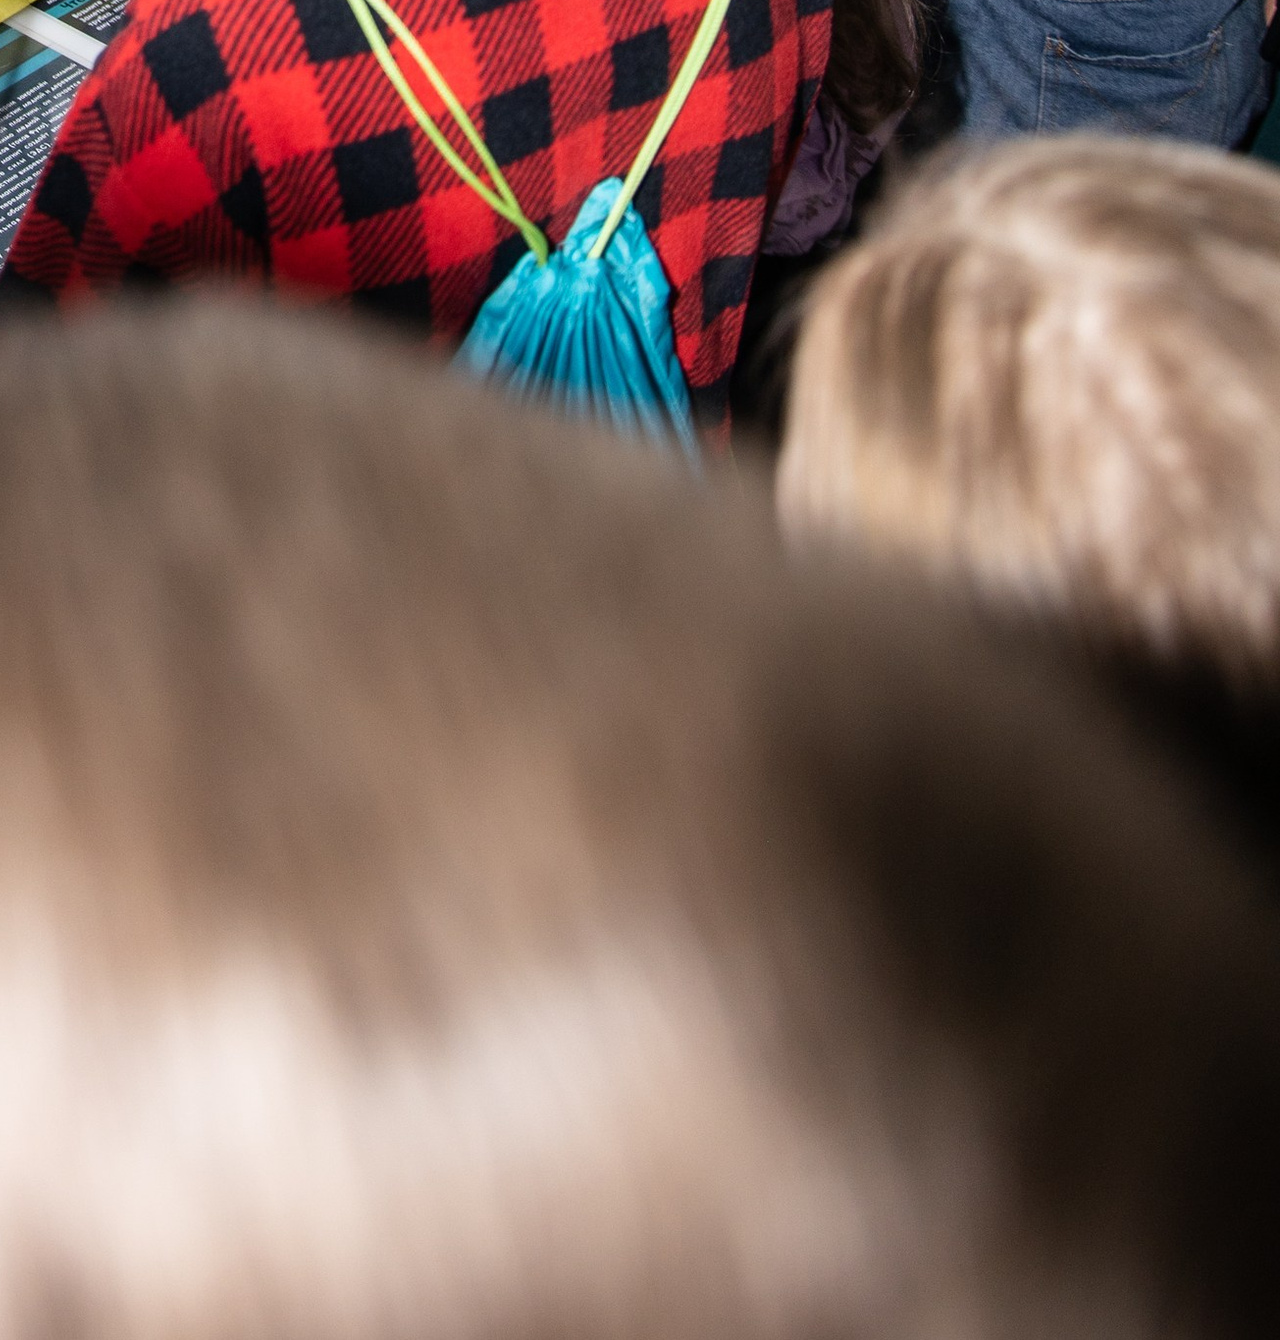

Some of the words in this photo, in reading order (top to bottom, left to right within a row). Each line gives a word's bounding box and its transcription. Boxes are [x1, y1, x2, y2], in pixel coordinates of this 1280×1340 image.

[14, 78, 50, 102] закреплён
[49, 60, 78, 80] сильный
[20, 90, 47, 109] медной
[6, 103, 43, 128] пластины,
[13, 115, 42, 134] медной
[39, 95, 73, 118] пластины
[7, 132, 32, 149] (токов
[5, 156, 28, 172] силы
[16, 154, 50, 176] вихревые
